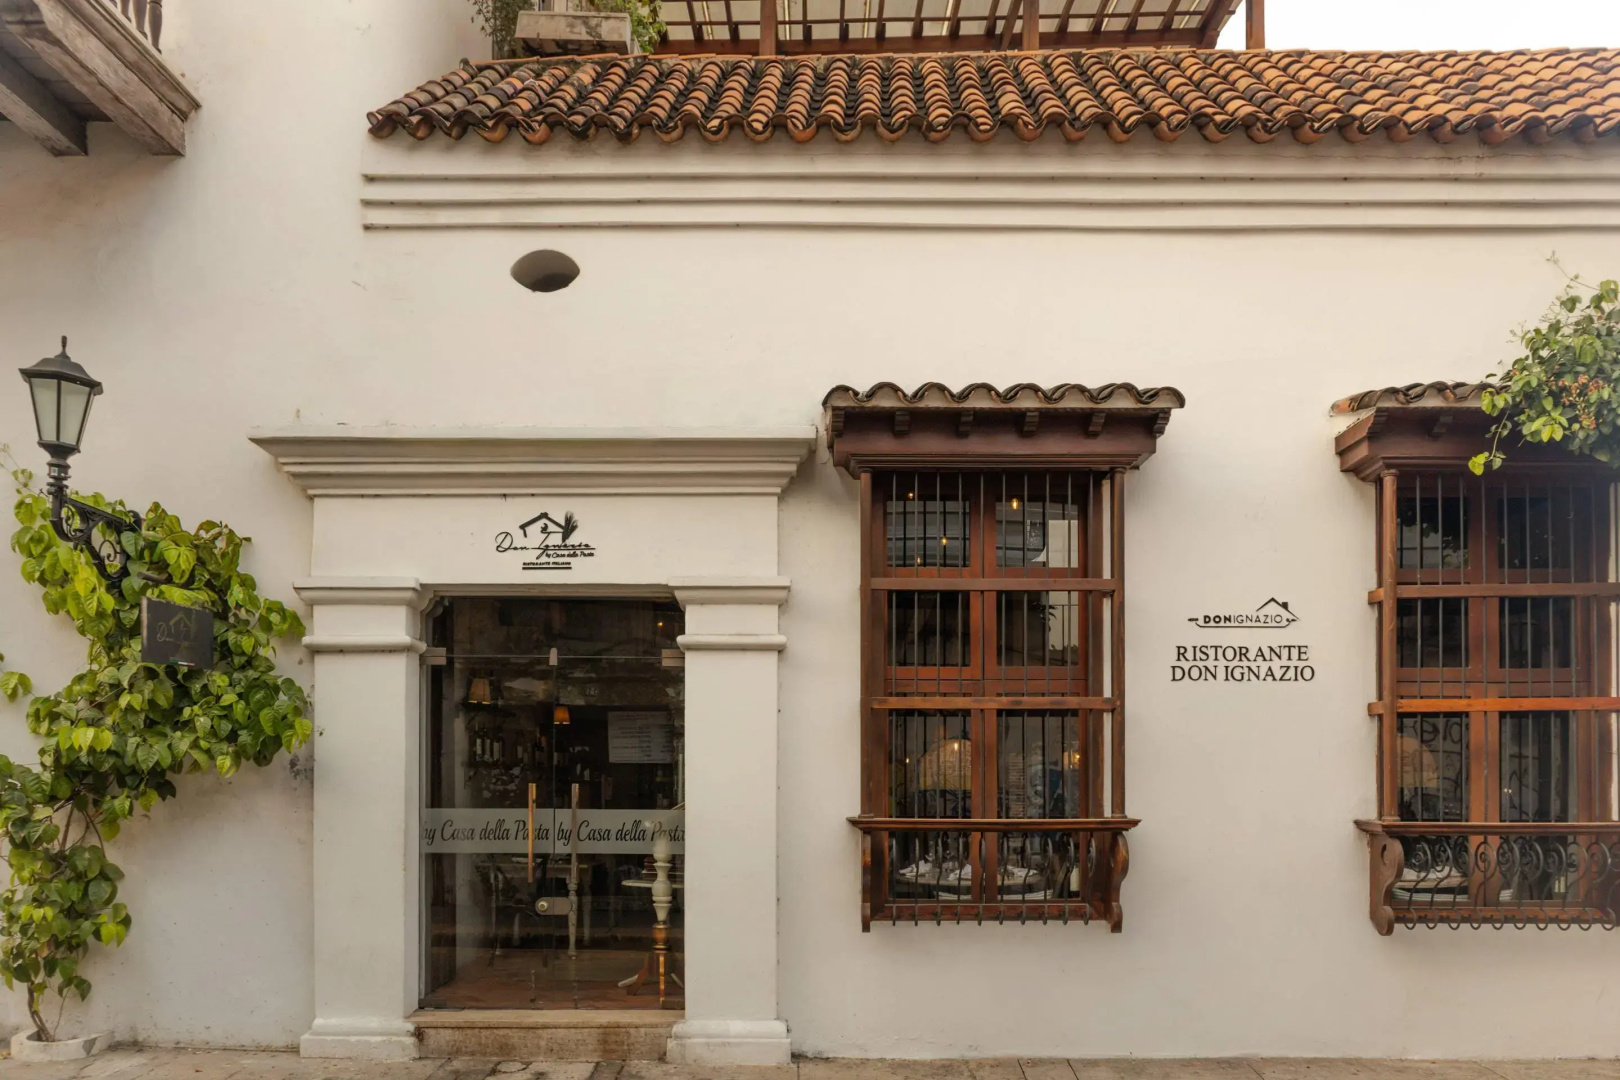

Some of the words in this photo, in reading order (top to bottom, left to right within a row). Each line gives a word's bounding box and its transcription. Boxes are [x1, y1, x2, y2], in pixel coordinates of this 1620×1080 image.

[494, 531, 530, 553] Don
[1175, 645, 1310, 662] RISTORANTE
[1170, 665, 1218, 682] DON
[1223, 665, 1316, 682] IGNAZIO
[441, 819, 476, 842] Casa
[479, 818, 511, 842] della
[556, 822, 573, 846] by
[577, 819, 612, 842] Casa
[615, 819, 648, 842] della
[650, 820, 685, 842] Pasta
